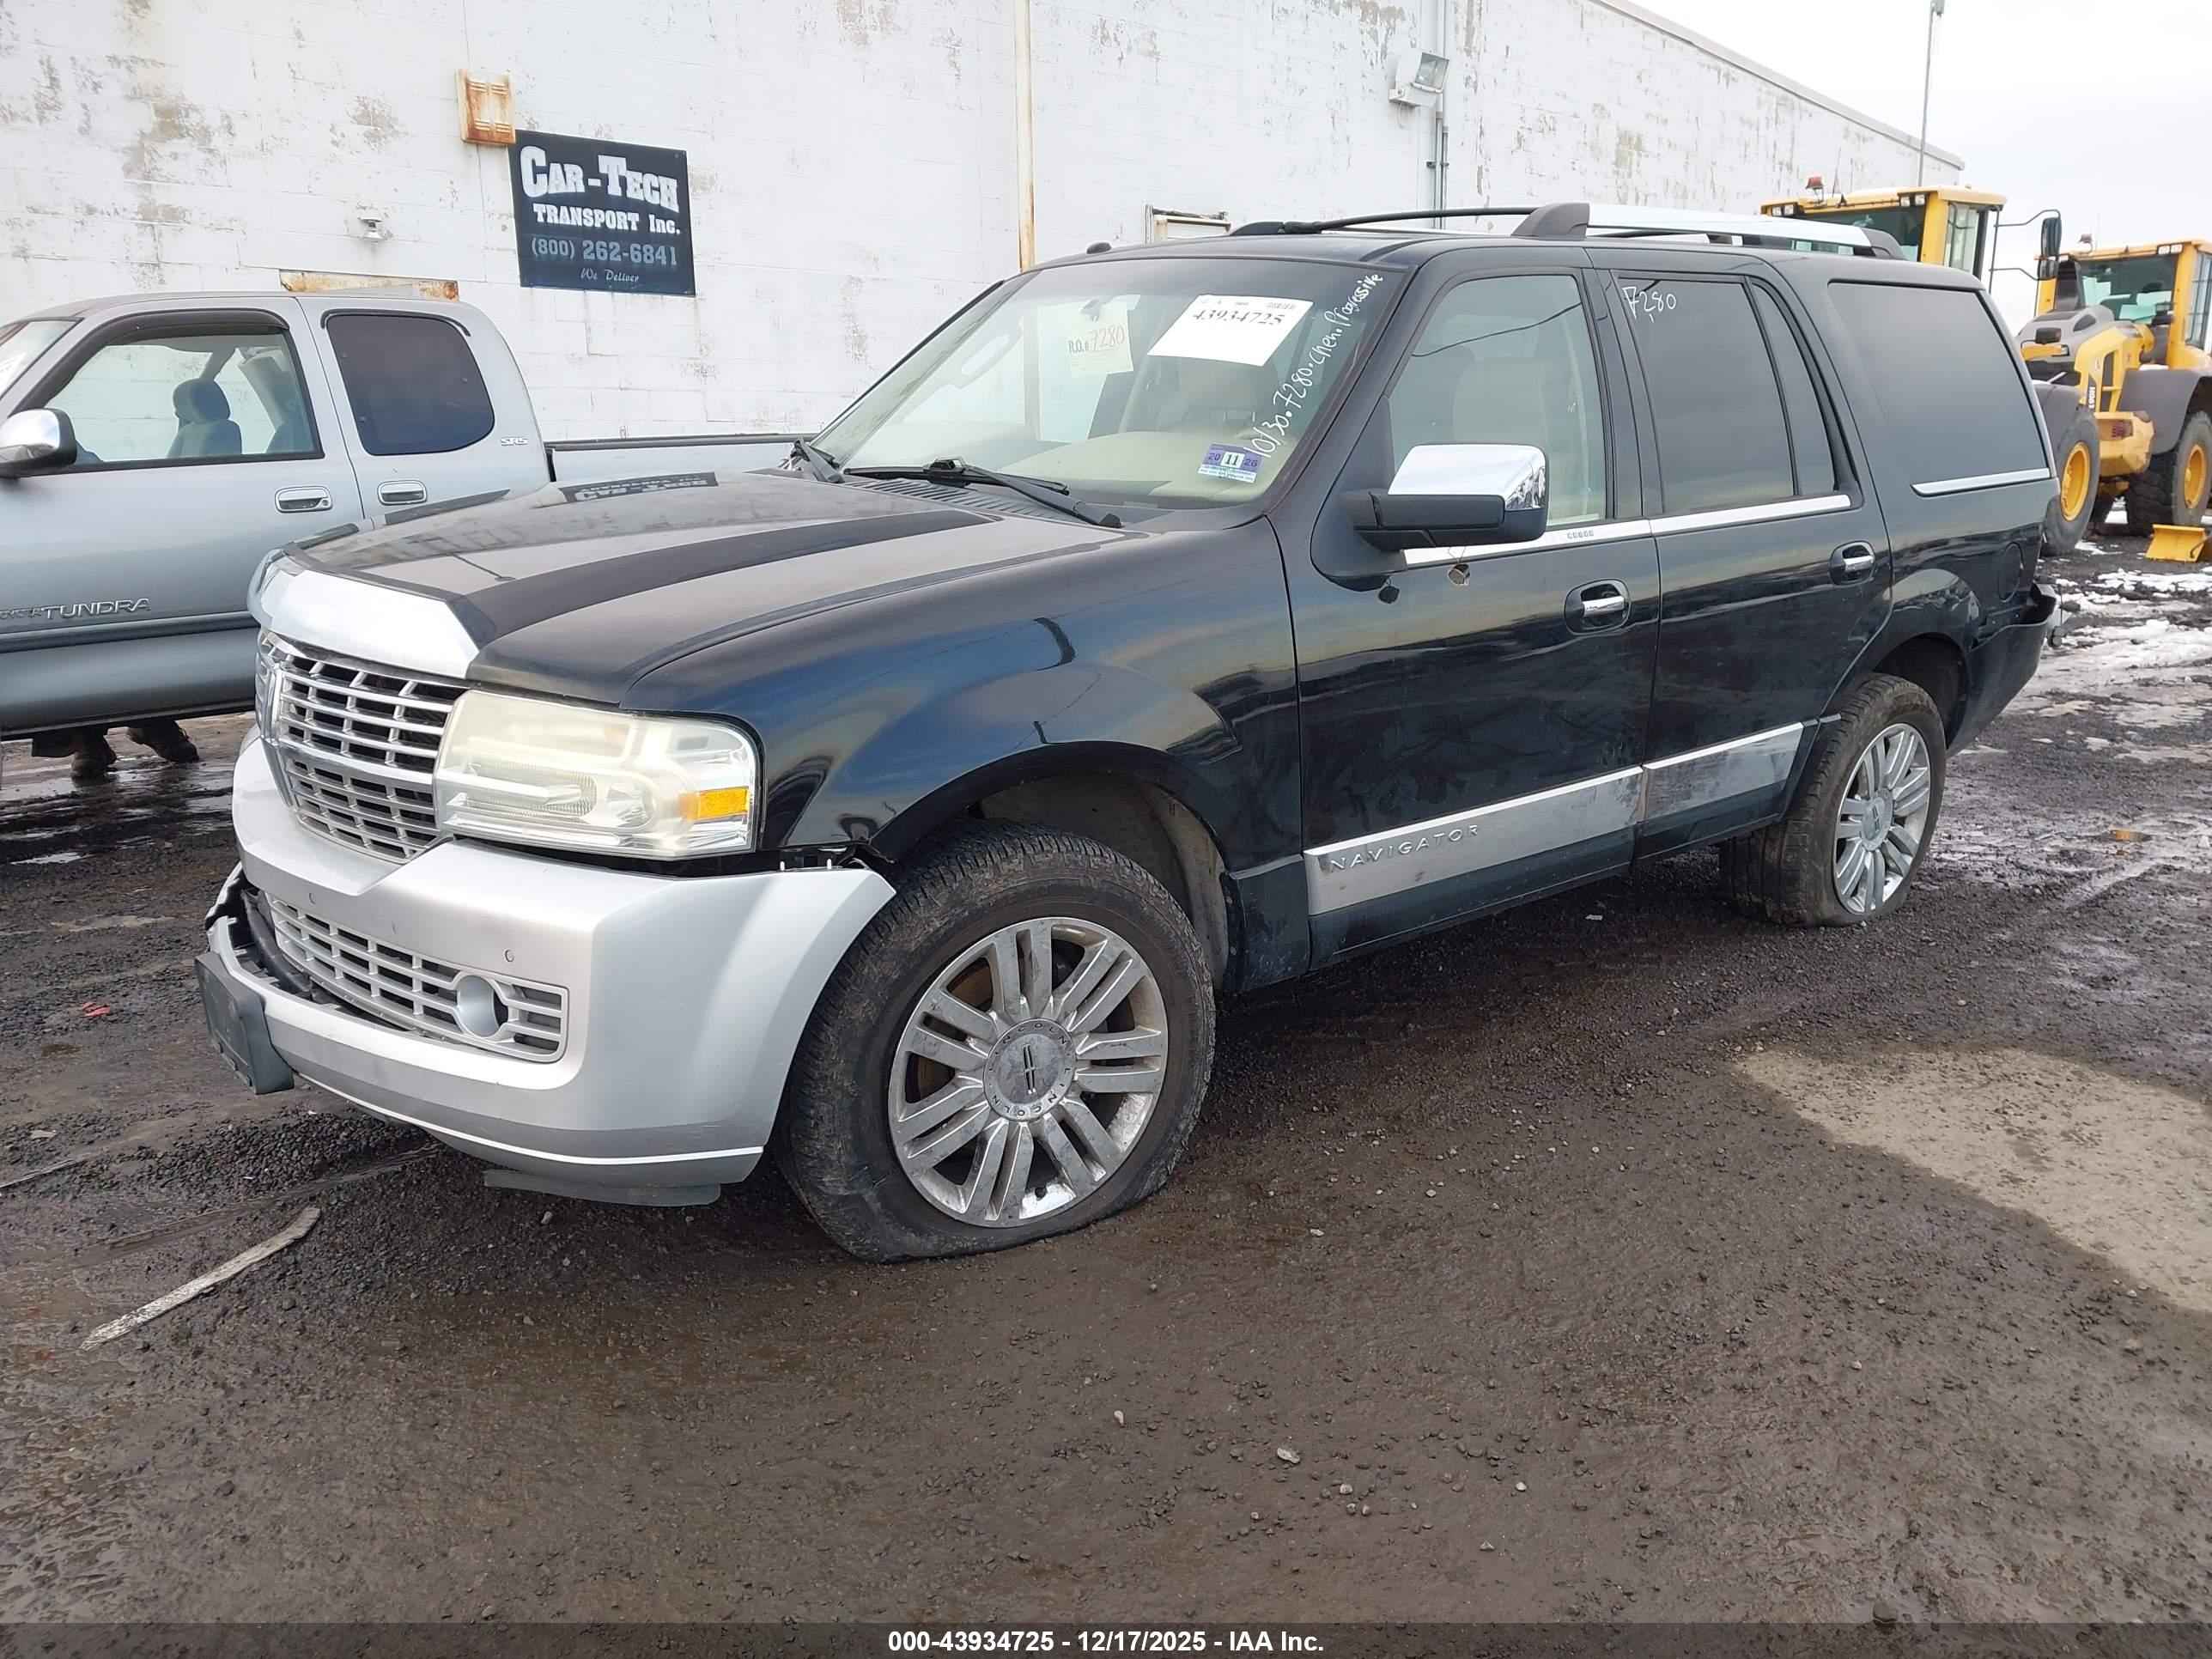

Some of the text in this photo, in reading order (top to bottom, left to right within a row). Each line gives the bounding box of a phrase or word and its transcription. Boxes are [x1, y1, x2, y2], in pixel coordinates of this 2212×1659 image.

[520, 146, 680, 213] CAR-TECH
[533, 204, 681, 235] TRANSPORT Inc.
[532, 237, 678, 265] (800) 262-6841
[580, 267, 640, 283] We Deliver
[1192, 308, 1286, 325] 43934725
[1088, 325, 1125, 350] 7280
[1225, 453, 1240, 465] 11
[1243, 458, 1260, 467] 26
[0, 598, 151, 620] OYOTA TUNDRA
[1330, 824, 1479, 870] NAVIGATOR
